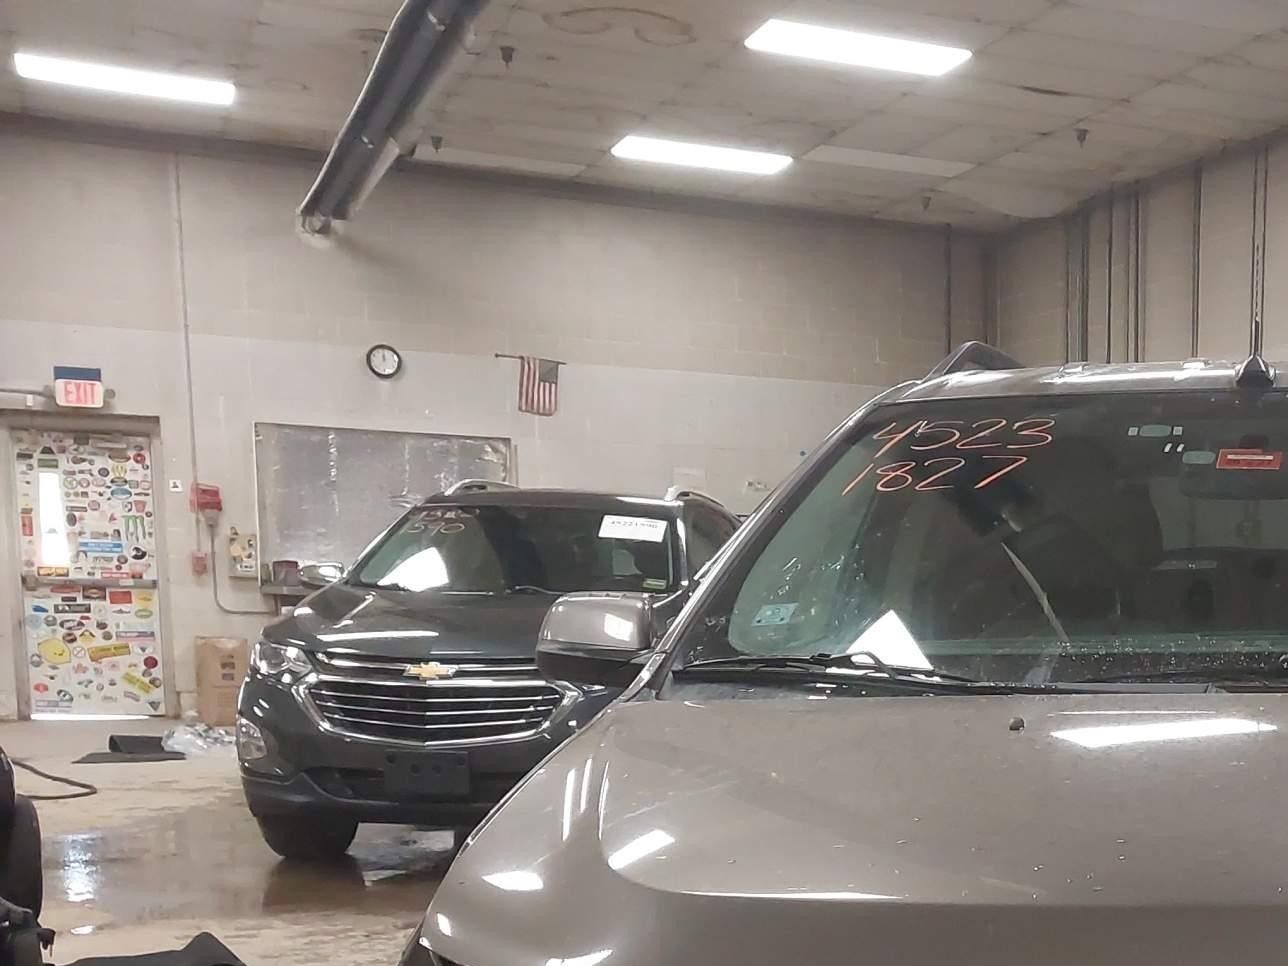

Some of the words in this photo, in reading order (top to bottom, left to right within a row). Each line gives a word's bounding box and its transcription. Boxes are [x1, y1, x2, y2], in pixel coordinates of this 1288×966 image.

[64, 381, 96, 404] EXIT
[873, 418, 1055, 458] 4523
[842, 455, 1028, 496] 1827
